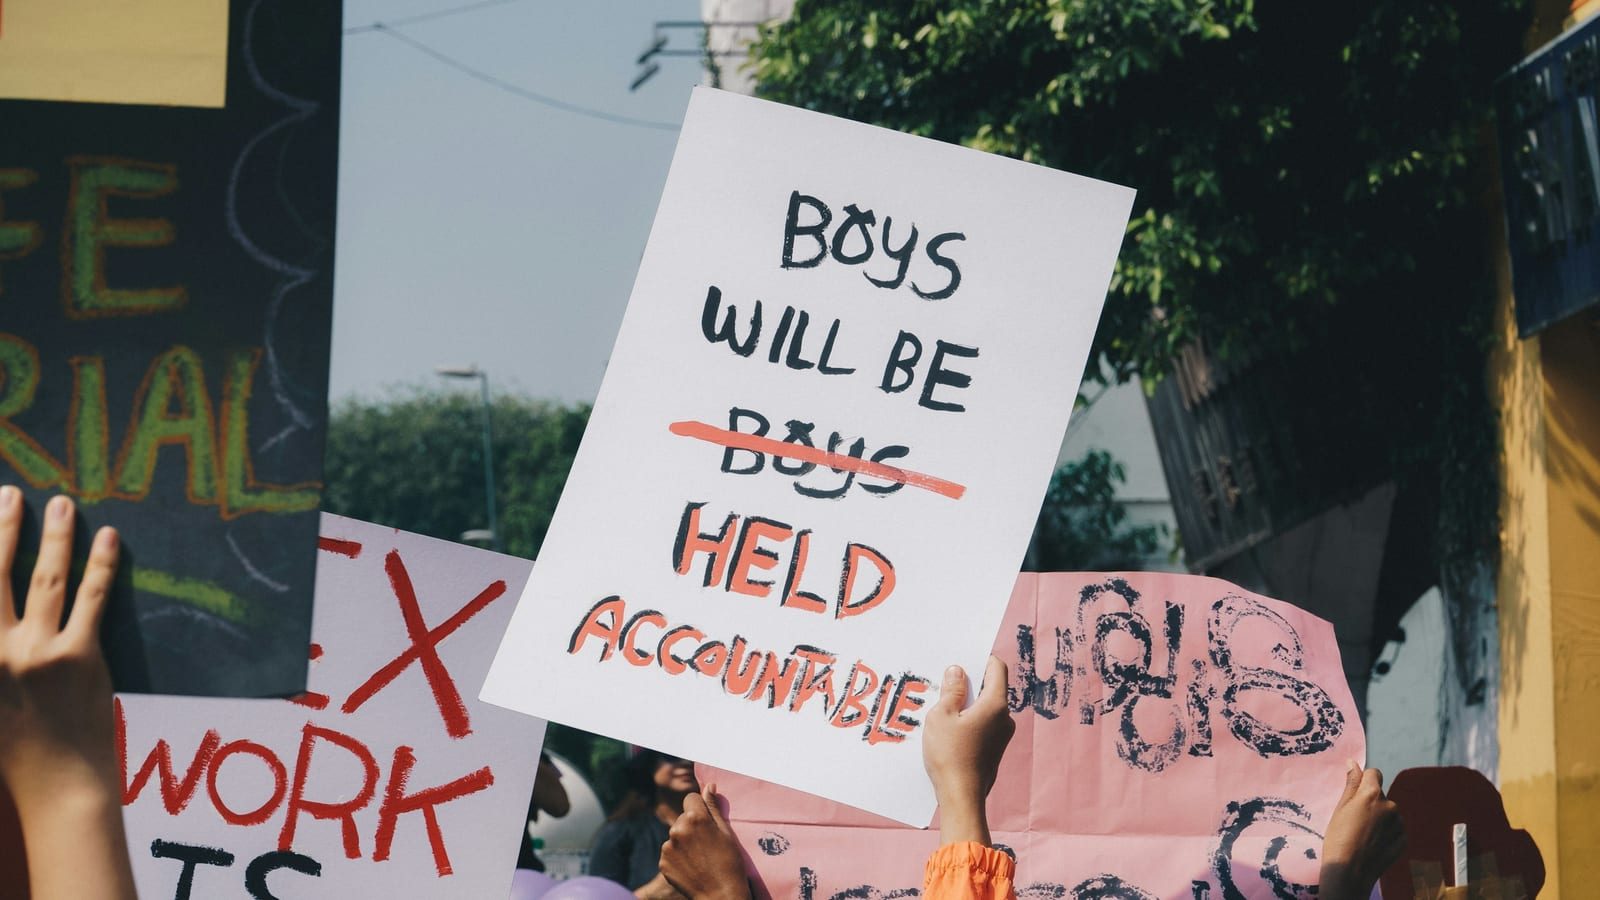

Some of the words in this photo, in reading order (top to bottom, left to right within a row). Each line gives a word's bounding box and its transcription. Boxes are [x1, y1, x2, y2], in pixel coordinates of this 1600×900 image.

[701, 285, 856, 375] WILL
[876, 329, 979, 412] BE
[672, 501, 896, 620] HELD
[567, 595, 931, 745] ACCOUNTABLE
[114, 697, 494, 877] WORK
